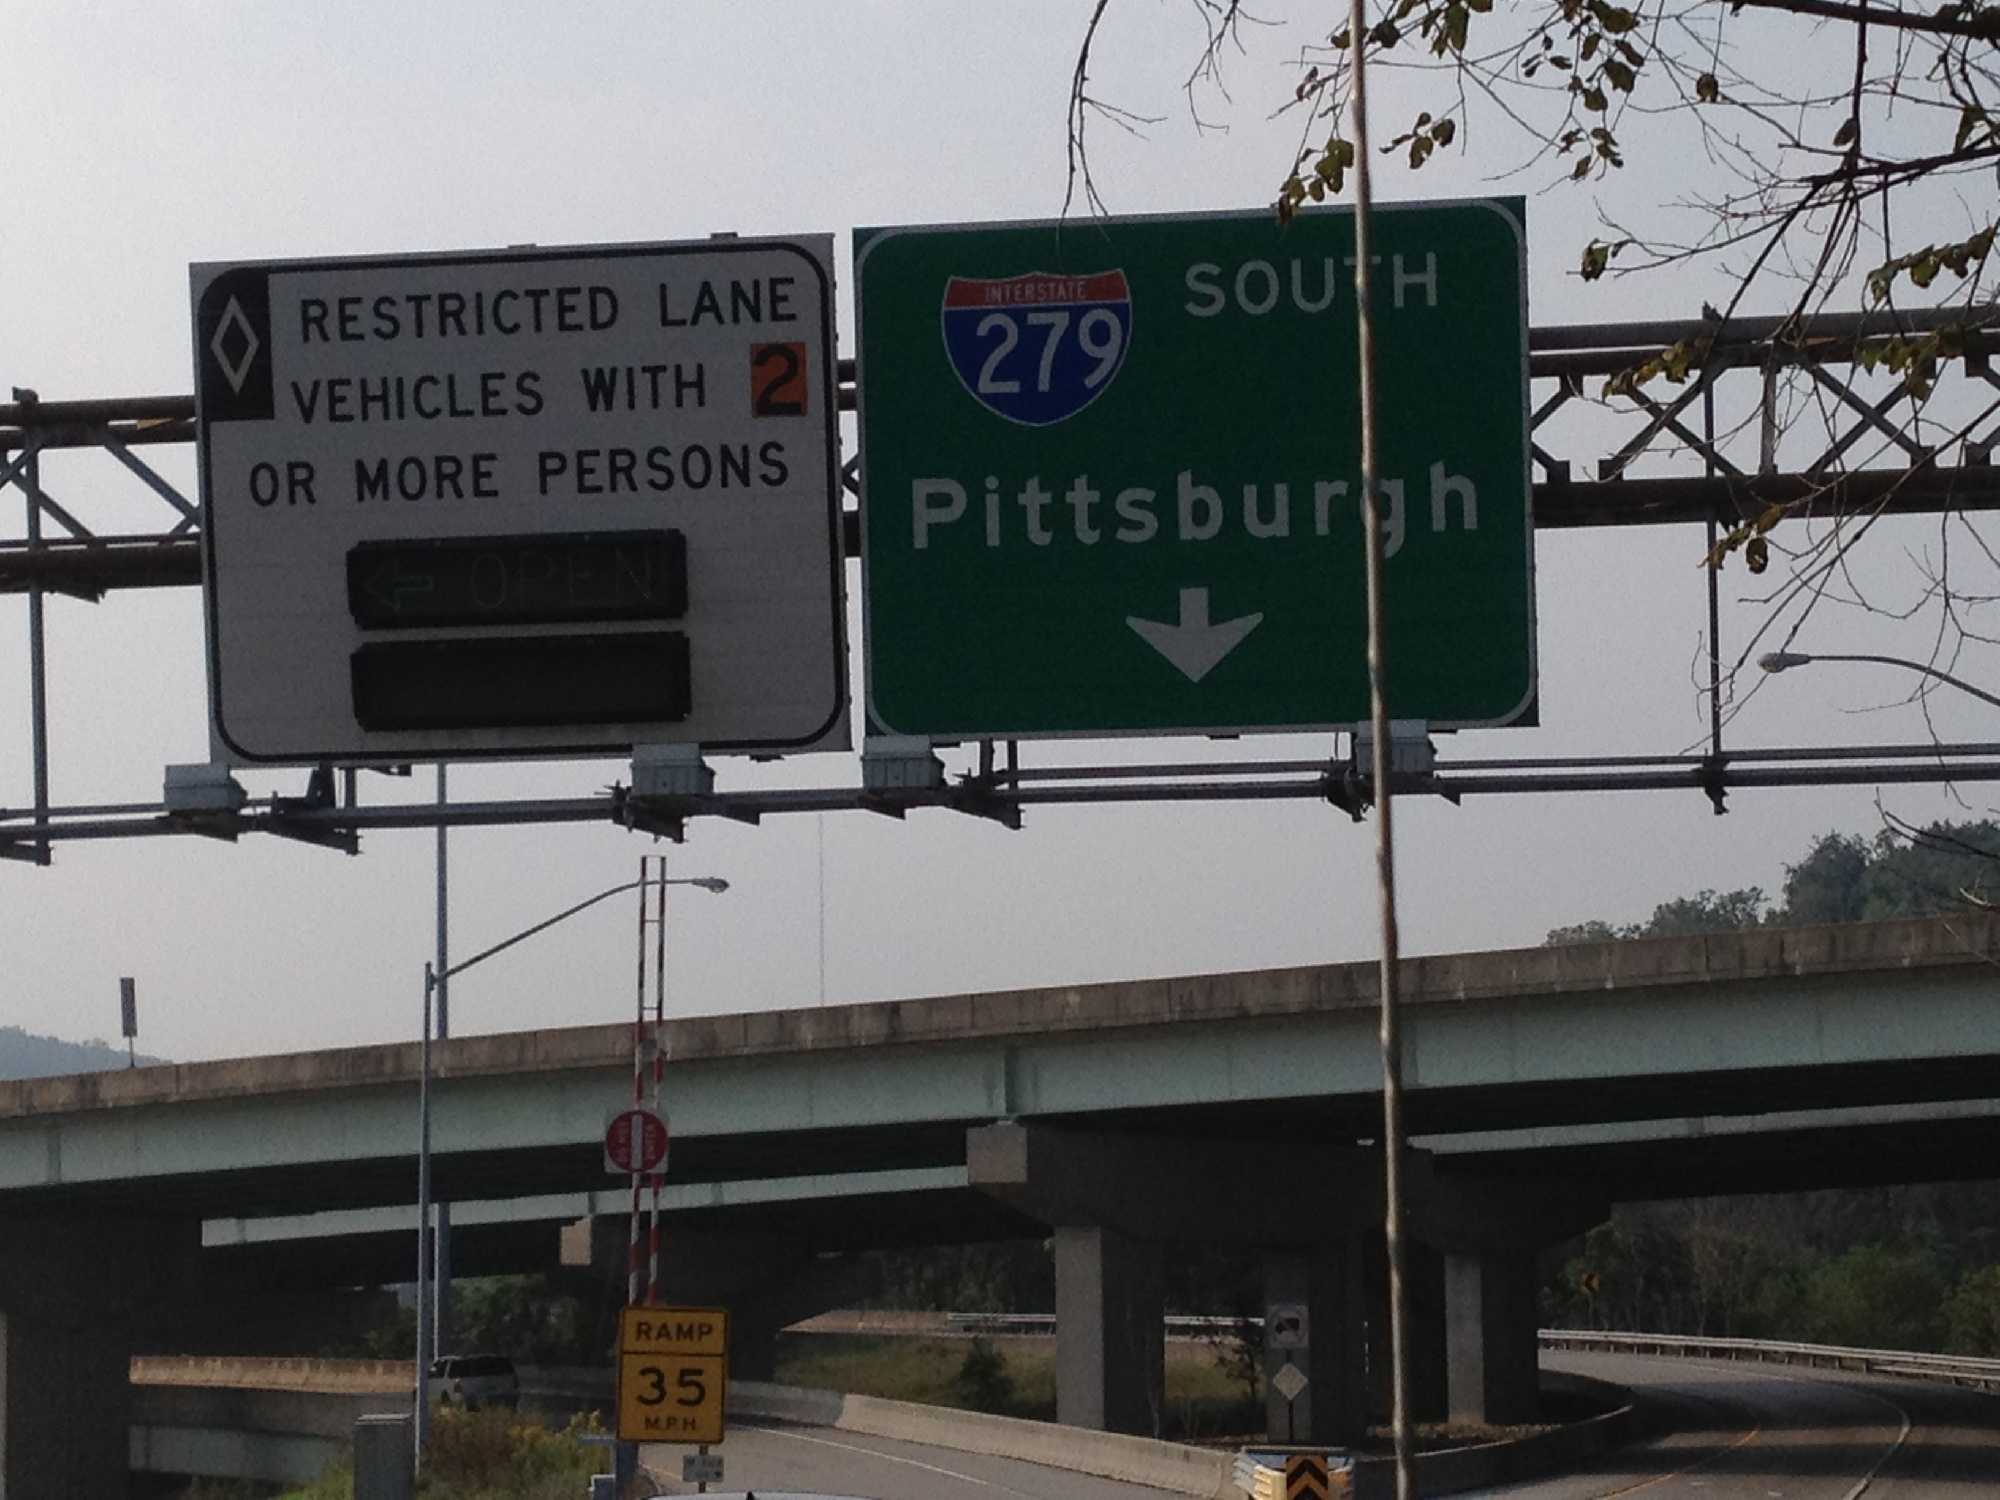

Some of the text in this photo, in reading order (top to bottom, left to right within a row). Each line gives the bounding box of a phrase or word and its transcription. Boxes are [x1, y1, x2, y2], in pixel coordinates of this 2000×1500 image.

[301, 276, 798, 343] RESTRICTED LANE
[984, 281, 1089, 303] INTERSTATE
[976, 308, 1123, 394] 279
[290, 346, 802, 425] VEHICLES WITH 2
[249, 440, 789, 507] OR MORE PERSONS
[911, 460, 1479, 560] Pittsburgh
[635, 1321, 714, 1342] RAMP
[636, 1367, 707, 1408] 35
